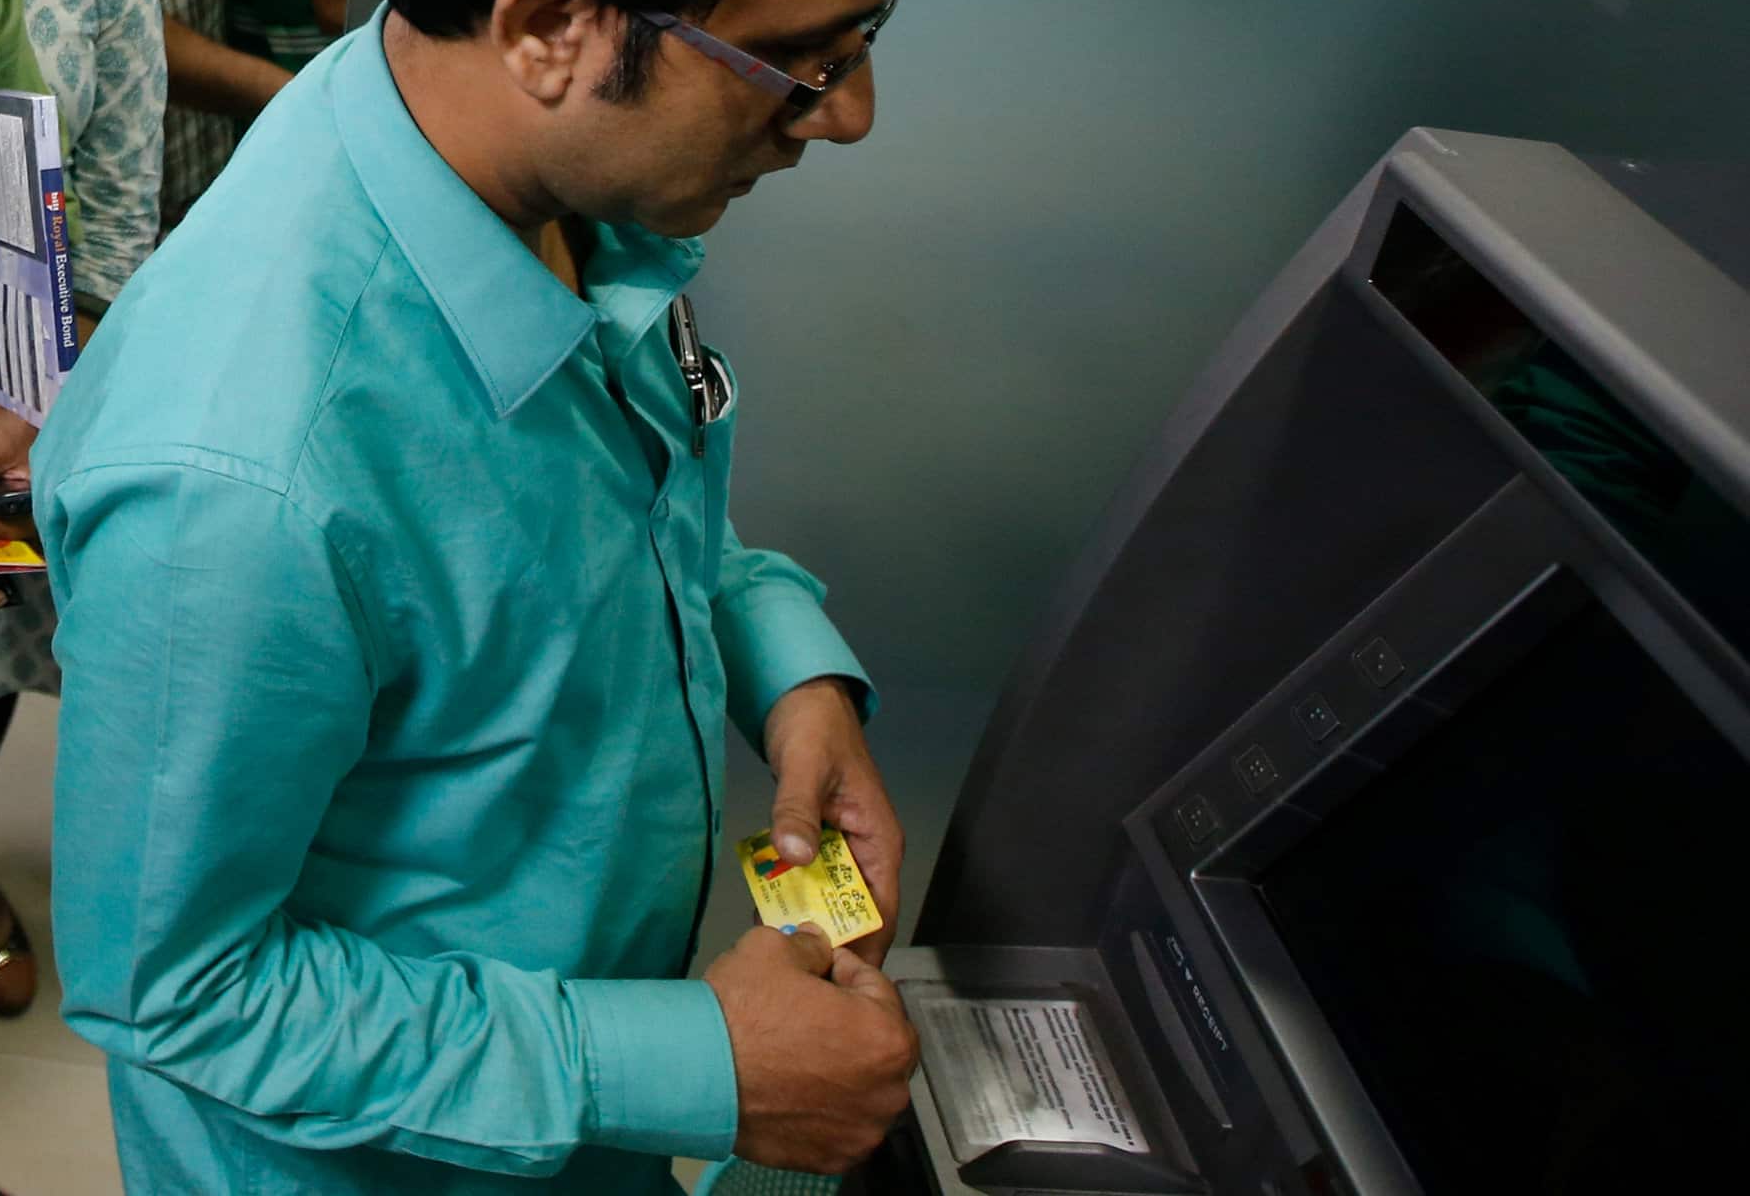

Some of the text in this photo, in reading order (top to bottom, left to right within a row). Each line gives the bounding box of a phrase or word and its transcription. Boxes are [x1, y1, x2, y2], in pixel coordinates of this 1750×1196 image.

[51, 216, 66, 252] Royal
[55, 254, 69, 313] Executive
[61, 315, 75, 348] Bond
[1192, 984, 1227, 1052] RECEIPT
